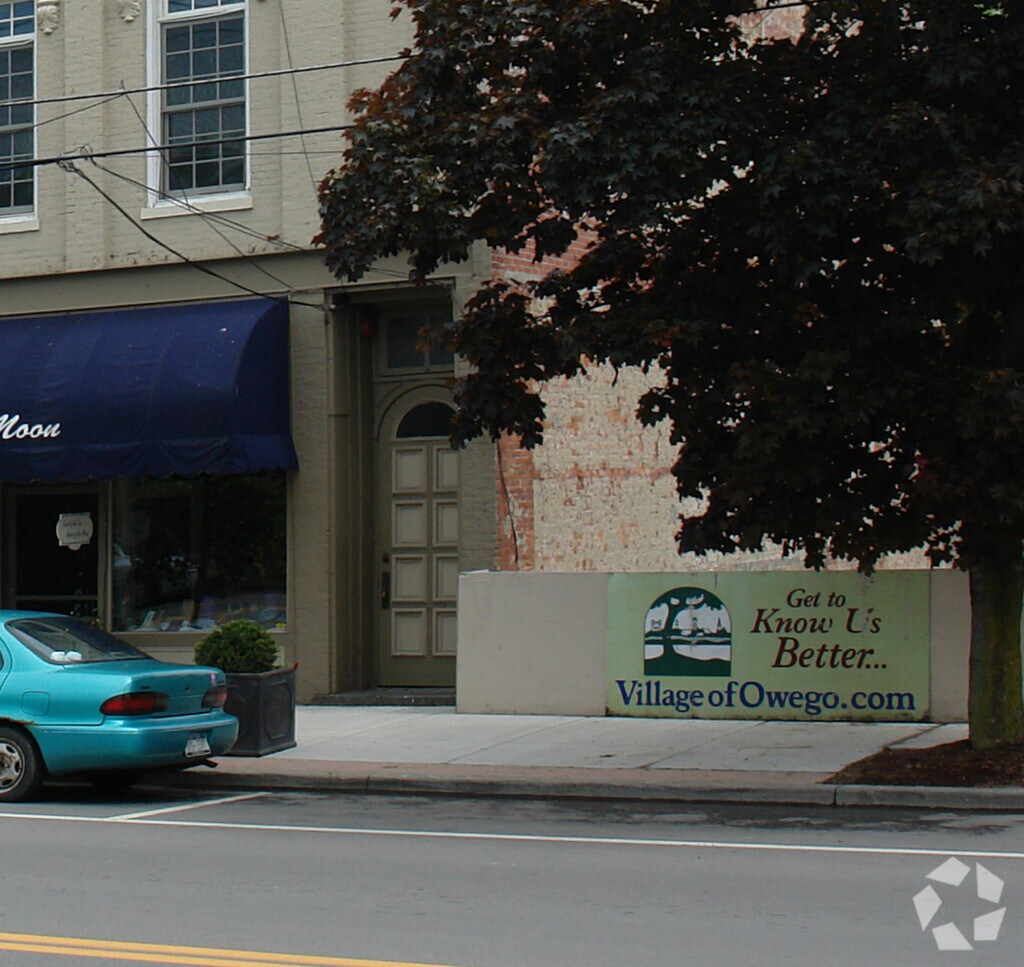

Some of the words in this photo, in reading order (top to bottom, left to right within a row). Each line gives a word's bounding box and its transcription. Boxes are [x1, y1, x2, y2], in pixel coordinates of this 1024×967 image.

[786, 588, 821, 608] Get
[827, 591, 847, 608] to
[750, 608, 833, 634] Know
[771, 636, 888, 669] Better...
